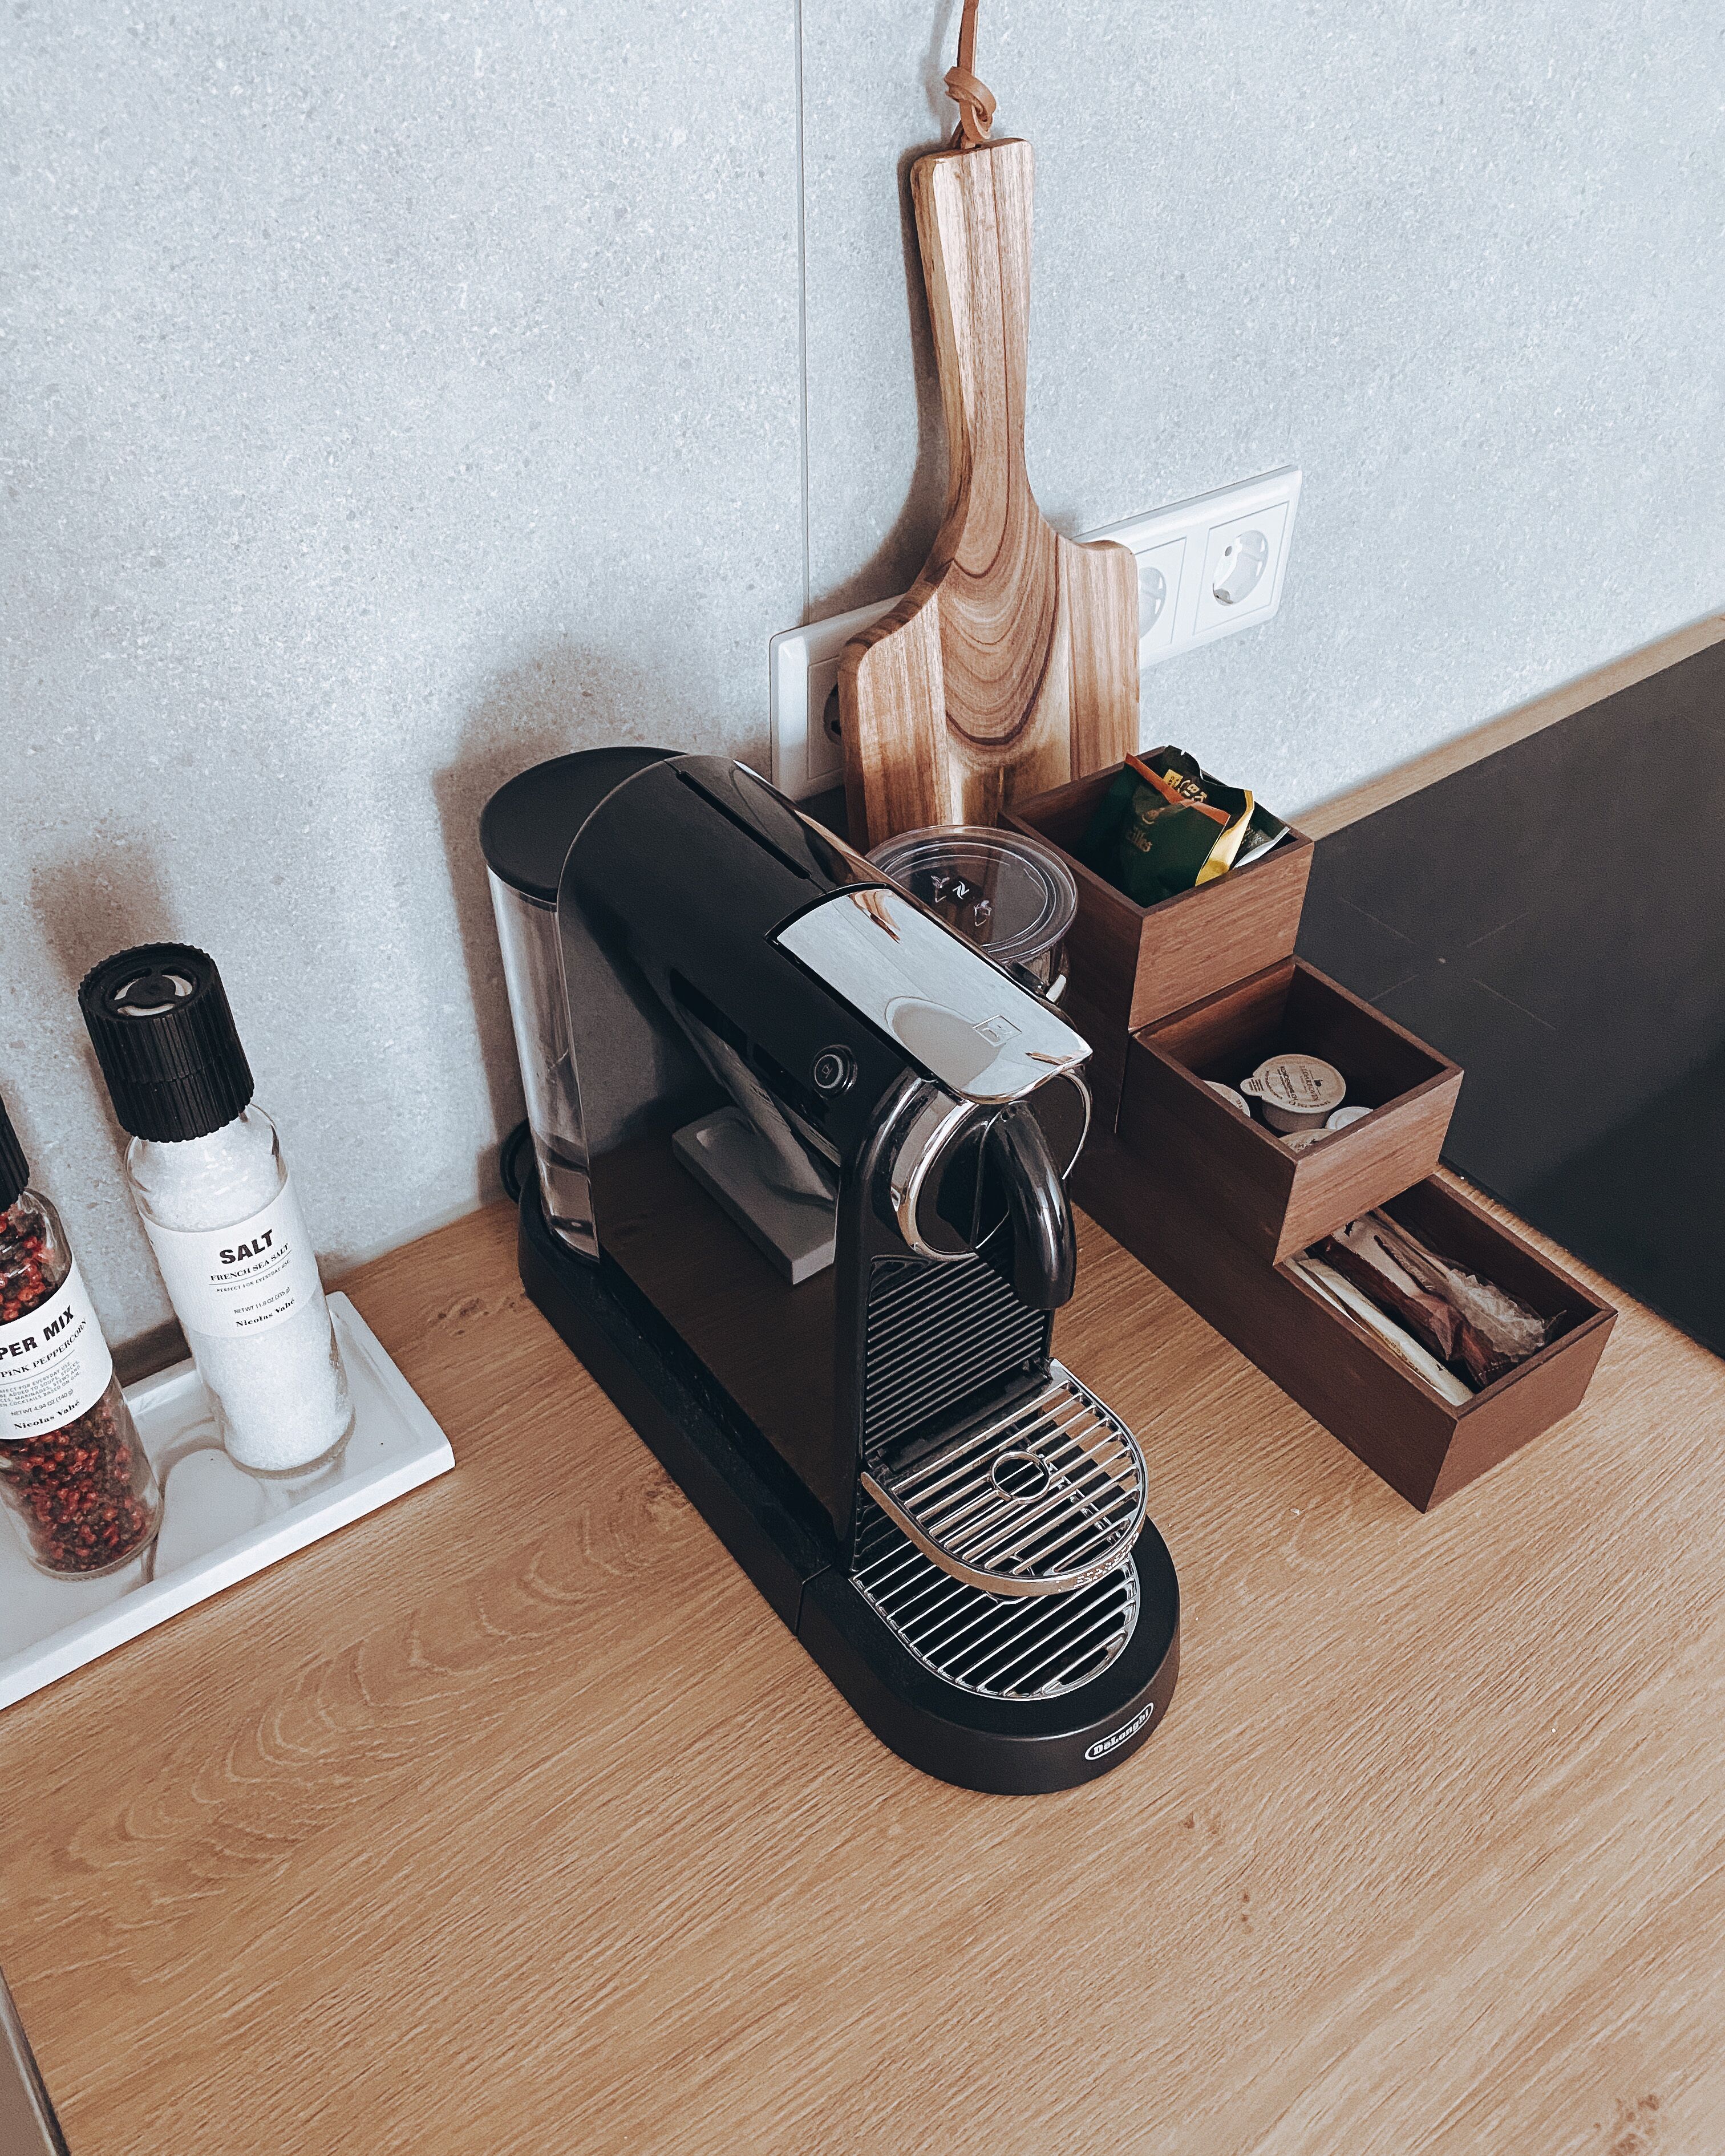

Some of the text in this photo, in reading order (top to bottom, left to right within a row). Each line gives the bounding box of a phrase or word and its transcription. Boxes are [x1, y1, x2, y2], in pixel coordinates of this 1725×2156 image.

[220, 1229, 272, 1265] SALT
[210, 1243, 289, 1281] FRENCH SEA SALT
[256, 1267, 281, 1284] EVERYDAY
[43, 1305, 75, 1341] MIX
[236, 1296, 295, 1328] Nicolas Vahé
[1, 1364, 30, 1378] PINK
[33, 1369, 59, 1385] EVERYDAY
[53, 1375, 70, 1387] STEWS
[71, 1365, 81, 1375] AND
[9, 1388, 29, 1397] ADDED
[10, 1395, 42, 1407] COCKTAILS
[43, 1385, 61, 1397] BASED
[14, 1399, 80, 1429] Nicolas Vahé
